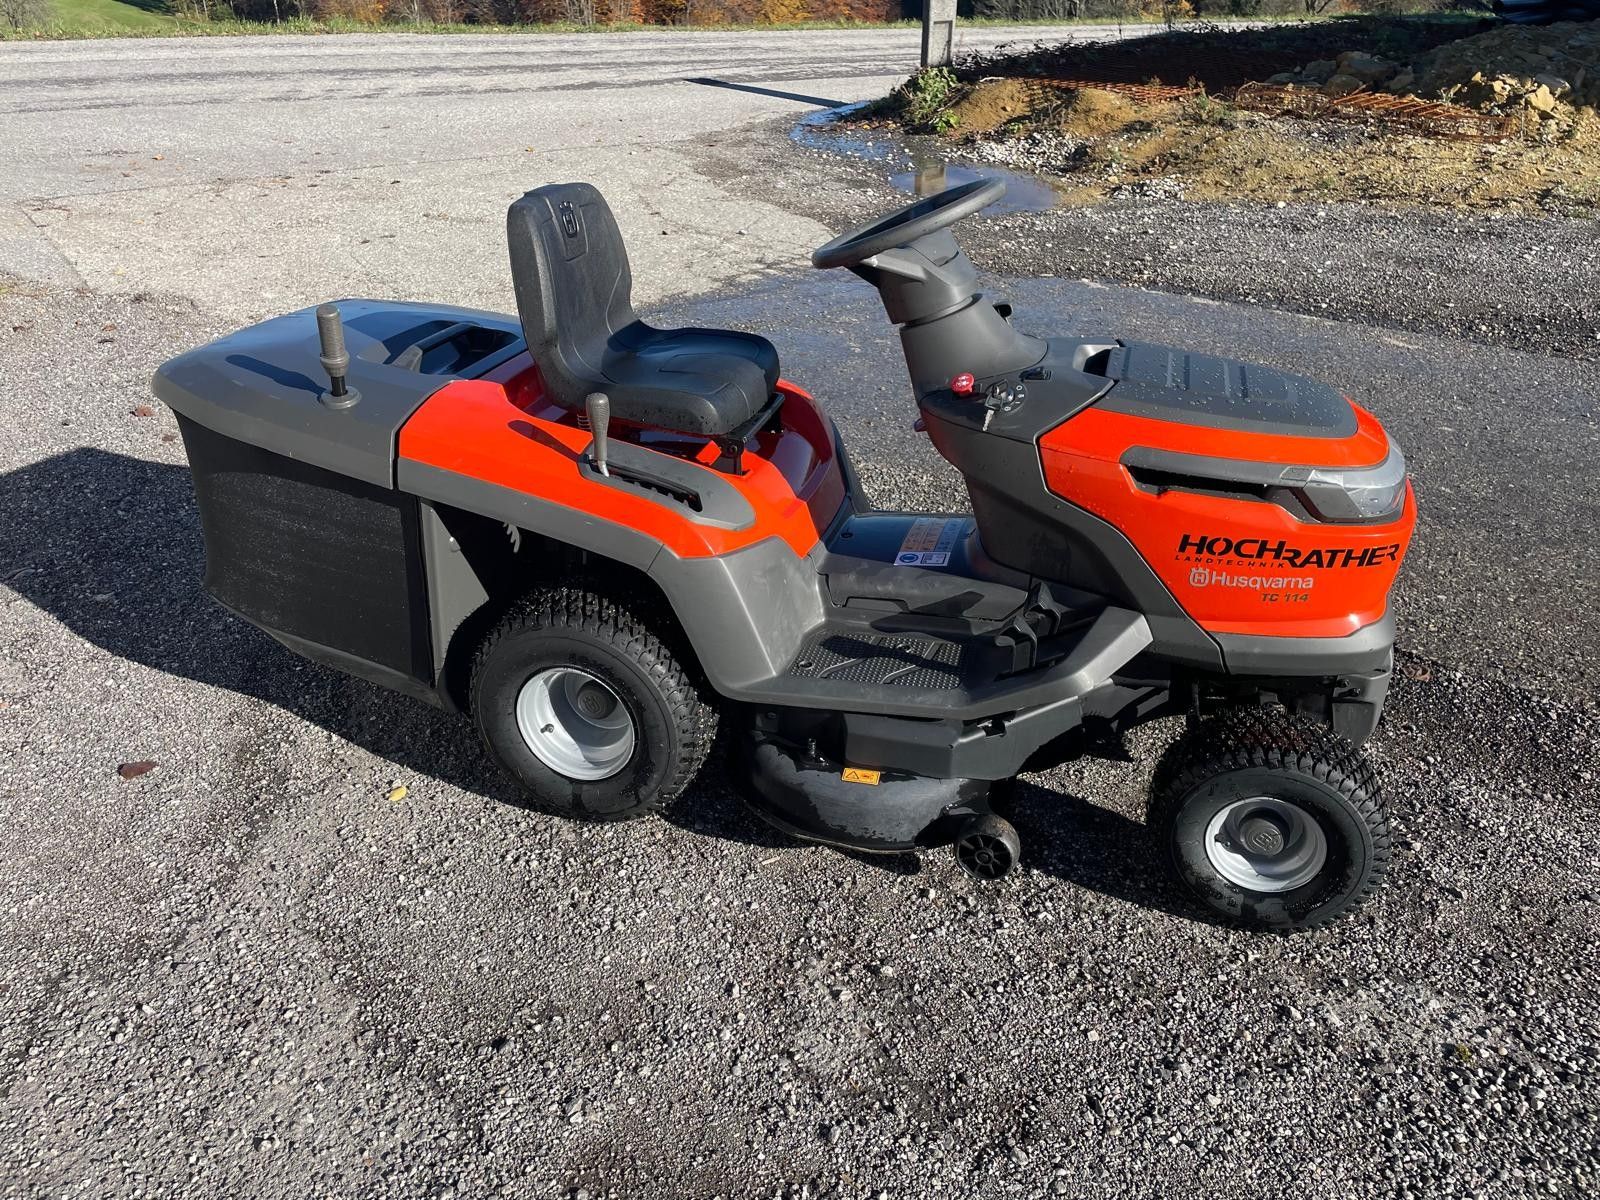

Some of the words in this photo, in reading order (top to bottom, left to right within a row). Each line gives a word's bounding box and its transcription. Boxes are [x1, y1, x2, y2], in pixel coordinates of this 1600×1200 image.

[1177, 534, 1400, 569] HOCHRATHER
[1174, 555, 1285, 569] LANDTECHNIK
[1211, 570, 1314, 590] Husqvarna
[1262, 593, 1280, 603] TC
[1285, 593, 1309, 603] 114
